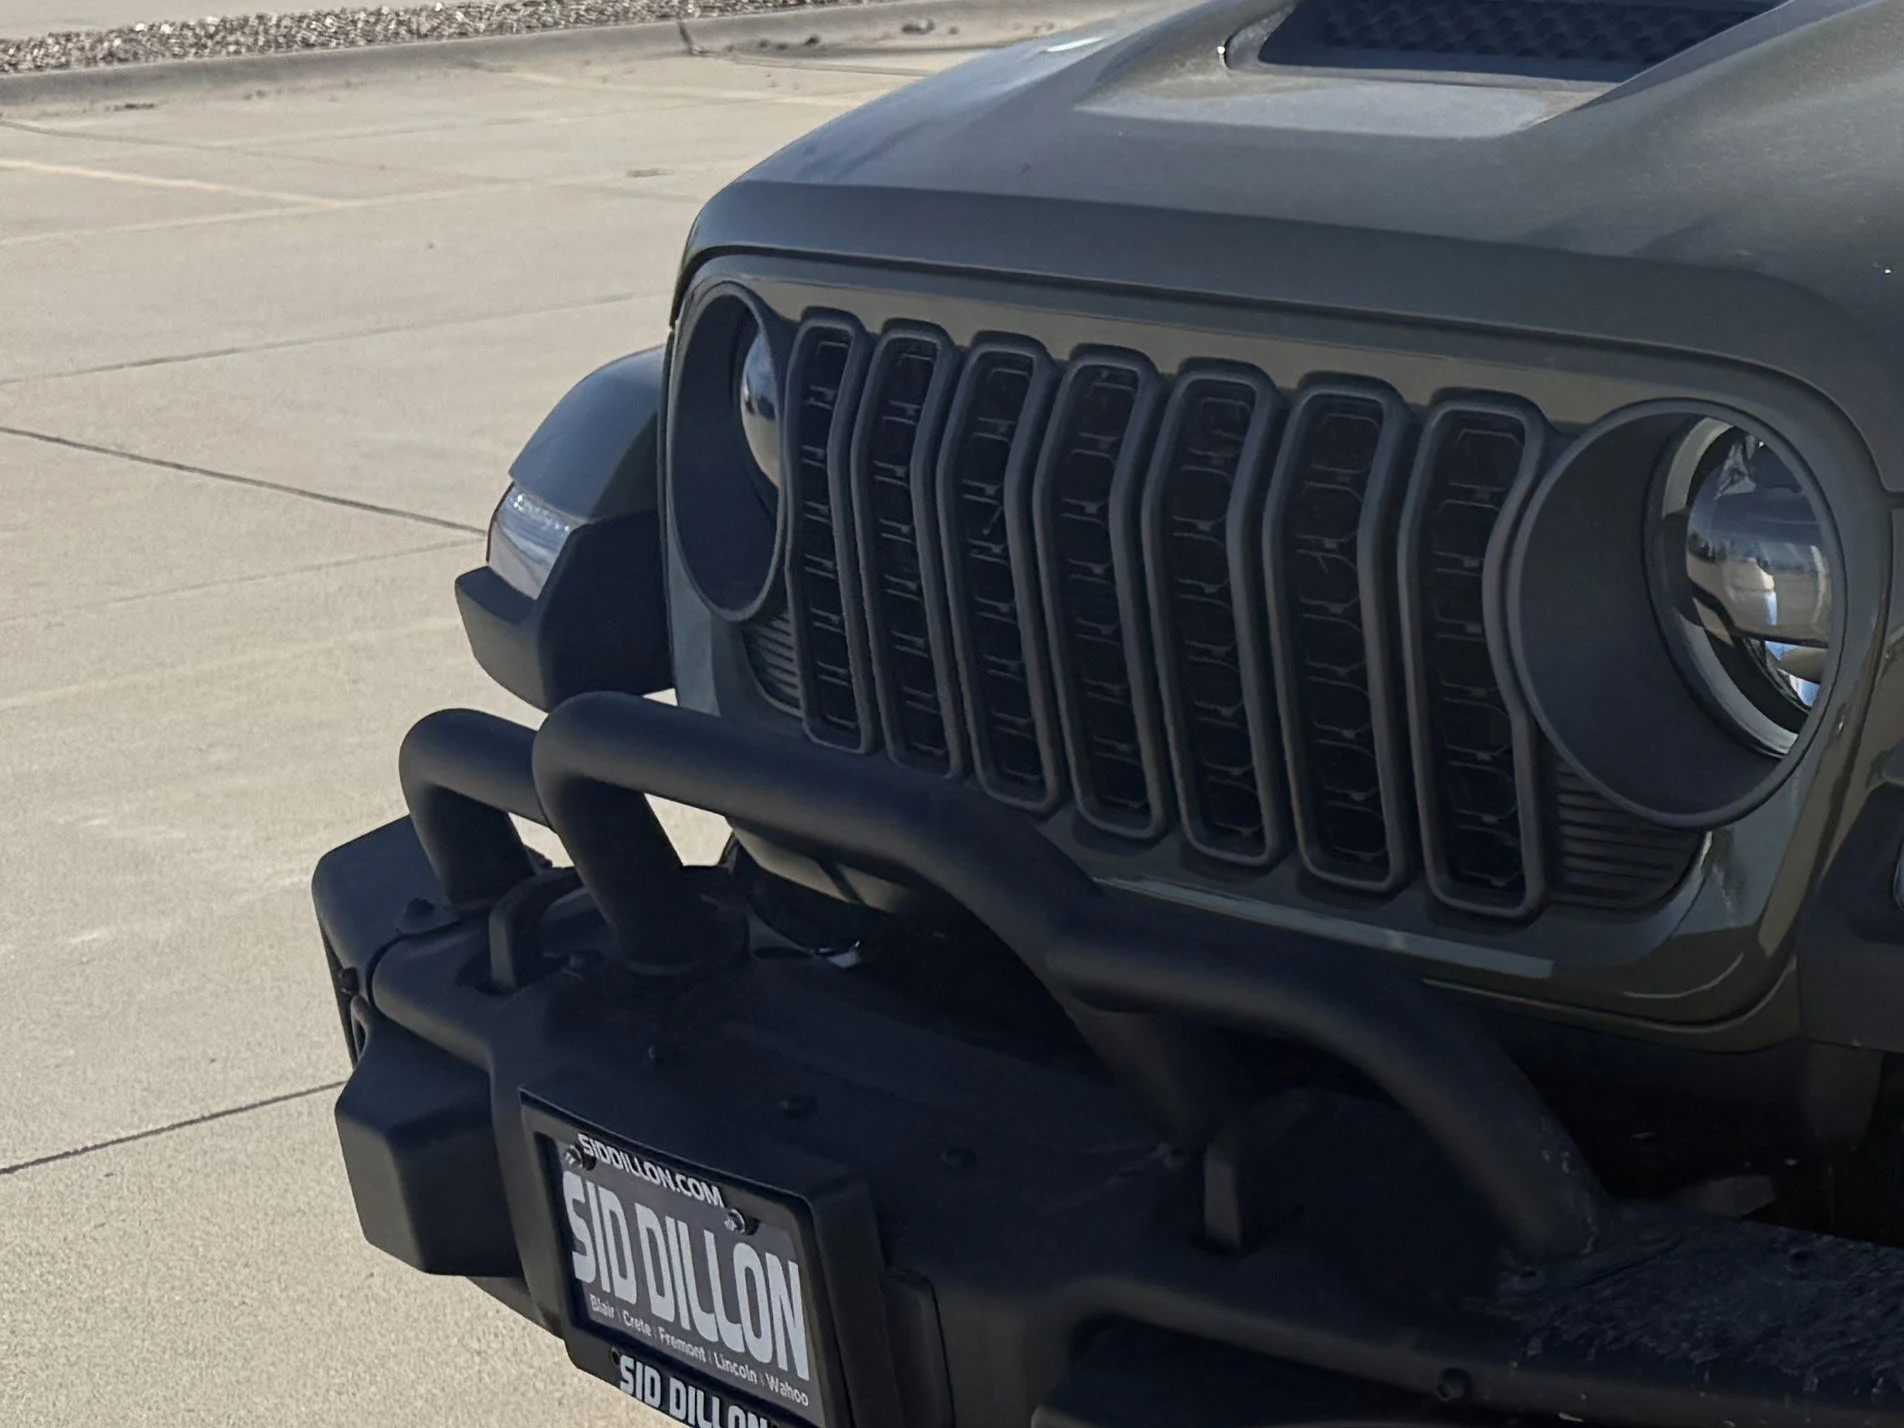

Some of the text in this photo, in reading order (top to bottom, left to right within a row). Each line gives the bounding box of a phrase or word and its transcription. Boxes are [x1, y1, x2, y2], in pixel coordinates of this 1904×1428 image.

[577, 1132, 725, 1209] SIDDILLON.COM
[562, 1170, 810, 1381] SID DILLON
[589, 1293, 809, 1407] Blair Crete Fremont Lincoln Wahoo
[619, 1354, 662, 1409] SID
